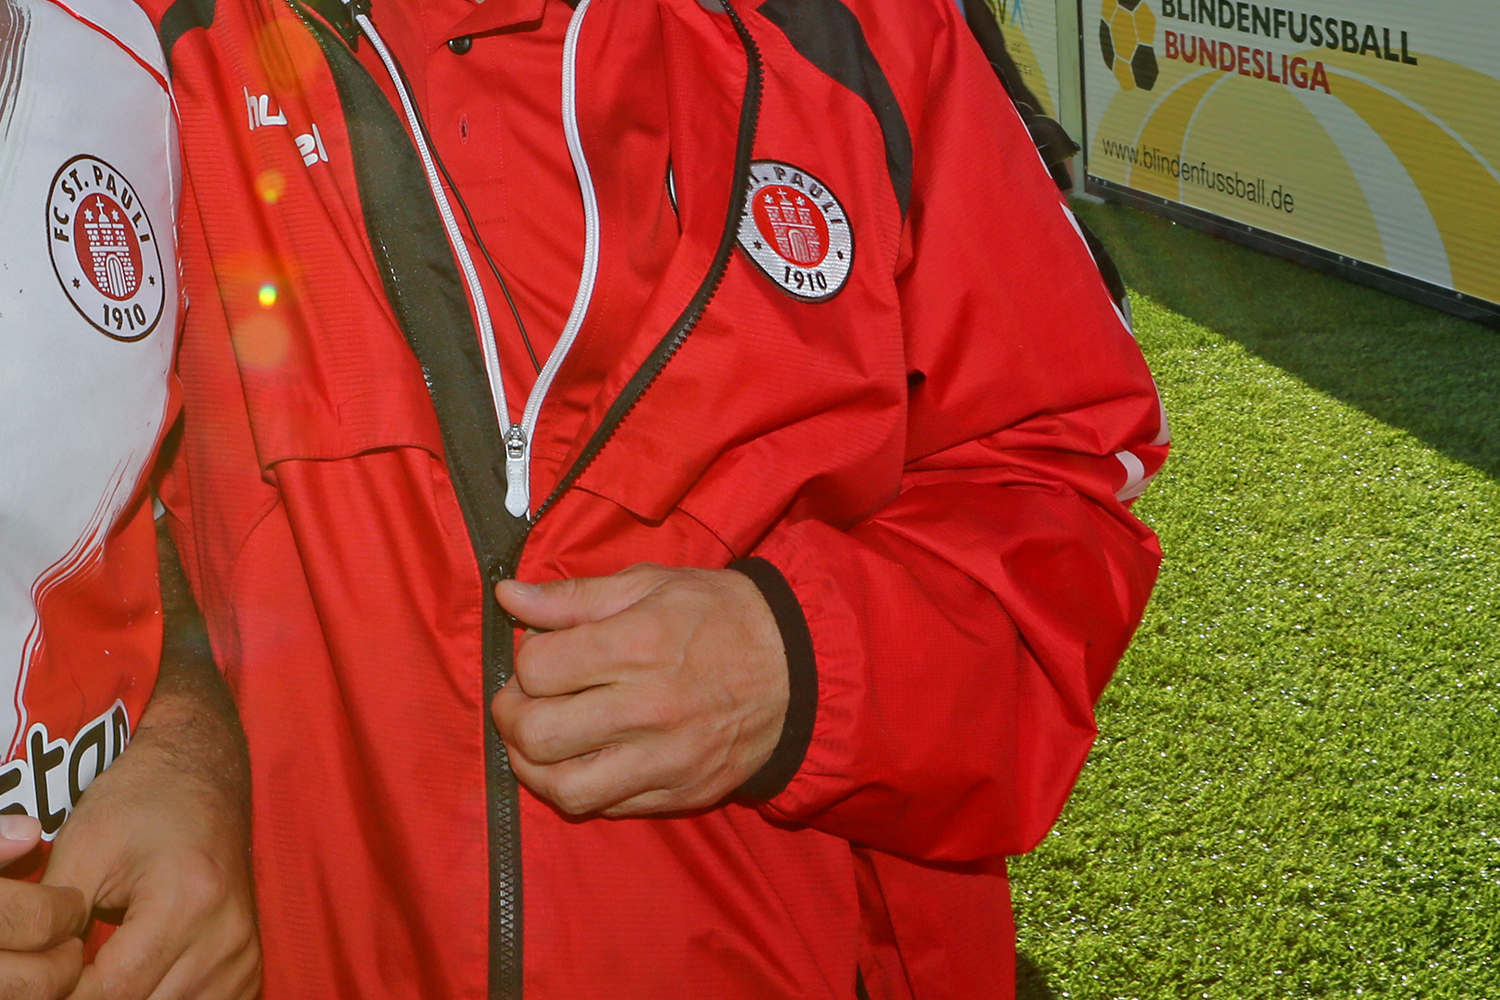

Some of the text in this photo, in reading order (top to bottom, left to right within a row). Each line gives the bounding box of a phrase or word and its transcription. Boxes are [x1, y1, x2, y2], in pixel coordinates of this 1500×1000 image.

[1164, 30, 1332, 95] BUNDESLIGA
[53, 164, 151, 243] FC ST. PAULI
[773, 166, 843, 224] PAULI
[1102, 138, 1295, 214] www.blindenfussball.de
[784, 265, 828, 291] 1910
[103, 303, 146, 331] 1910
